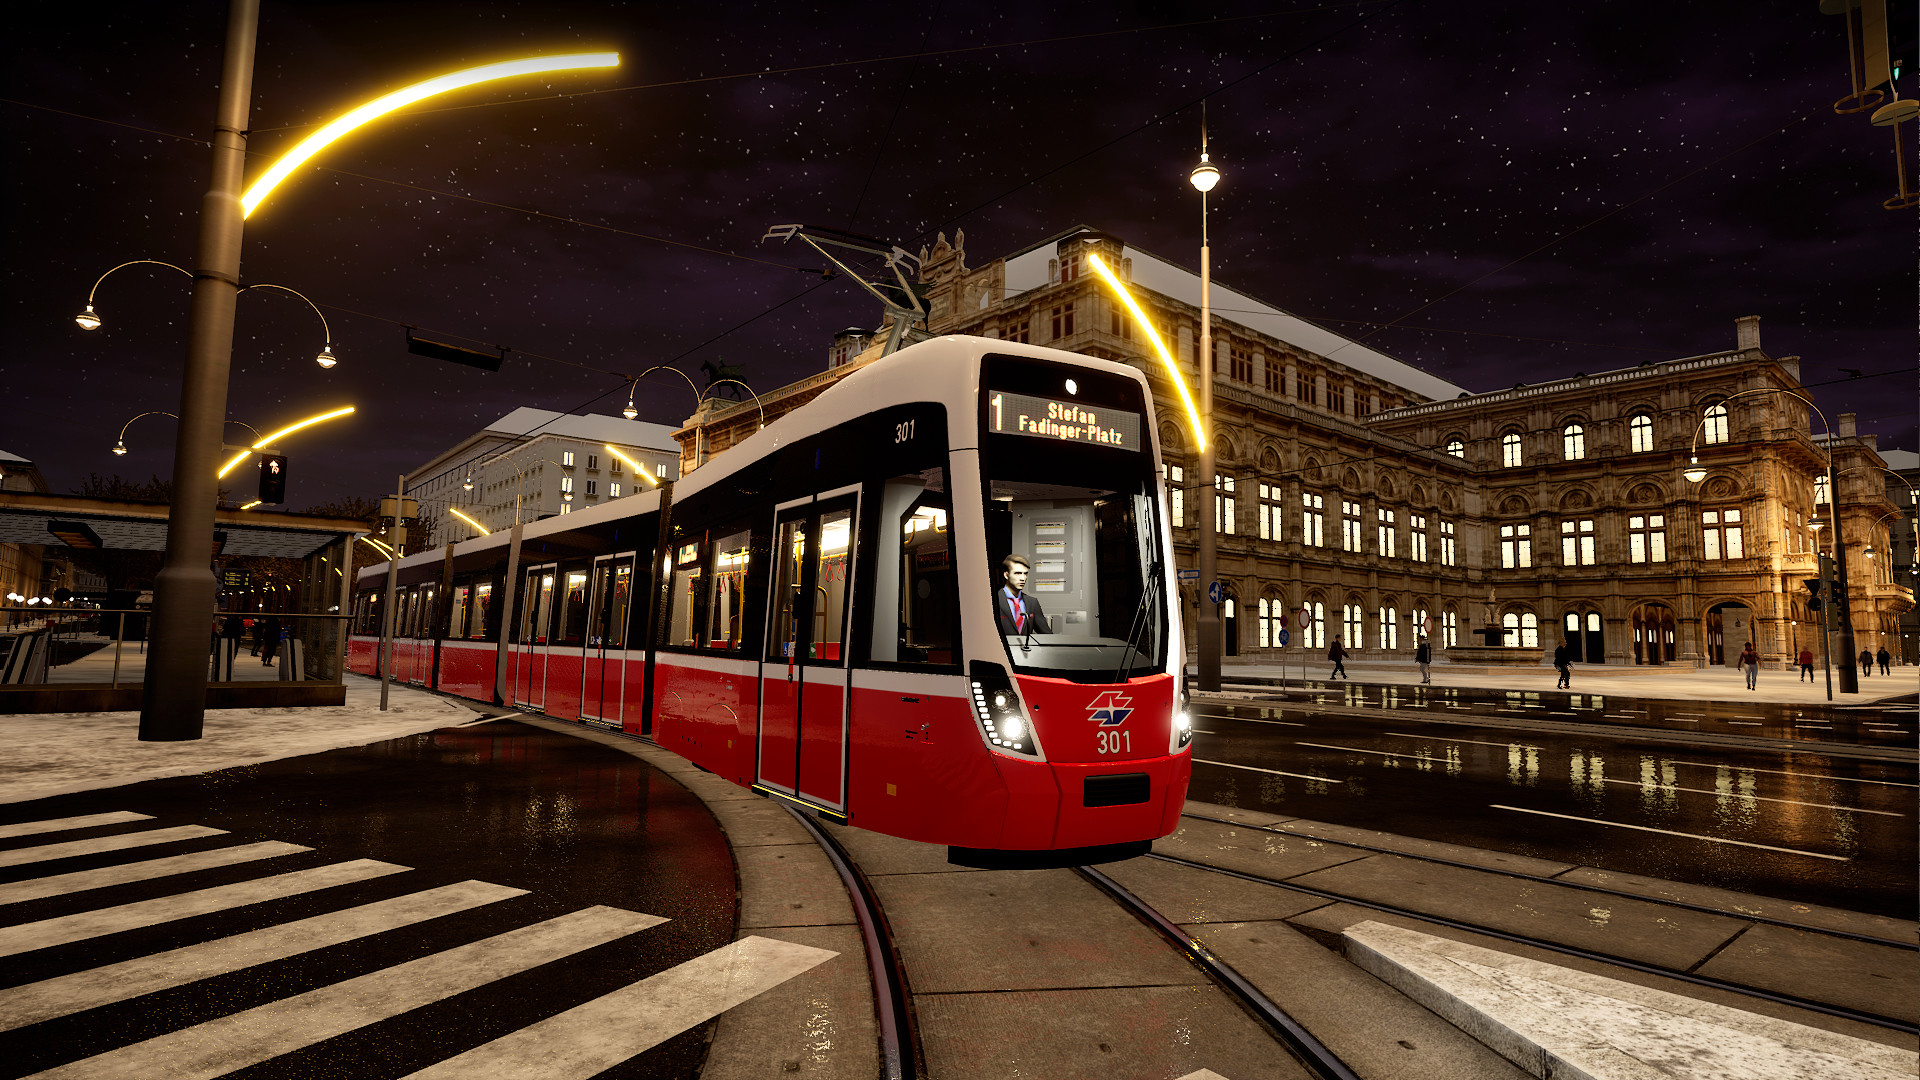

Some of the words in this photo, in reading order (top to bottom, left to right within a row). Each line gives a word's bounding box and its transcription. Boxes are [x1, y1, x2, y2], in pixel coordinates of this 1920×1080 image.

[991, 393, 1002, 431] 1
[1048, 402, 1096, 425] Stefan
[895, 419, 915, 444] 301
[1018, 414, 1123, 445] Fadinger-Platz
[1096, 730, 1131, 754] 301
